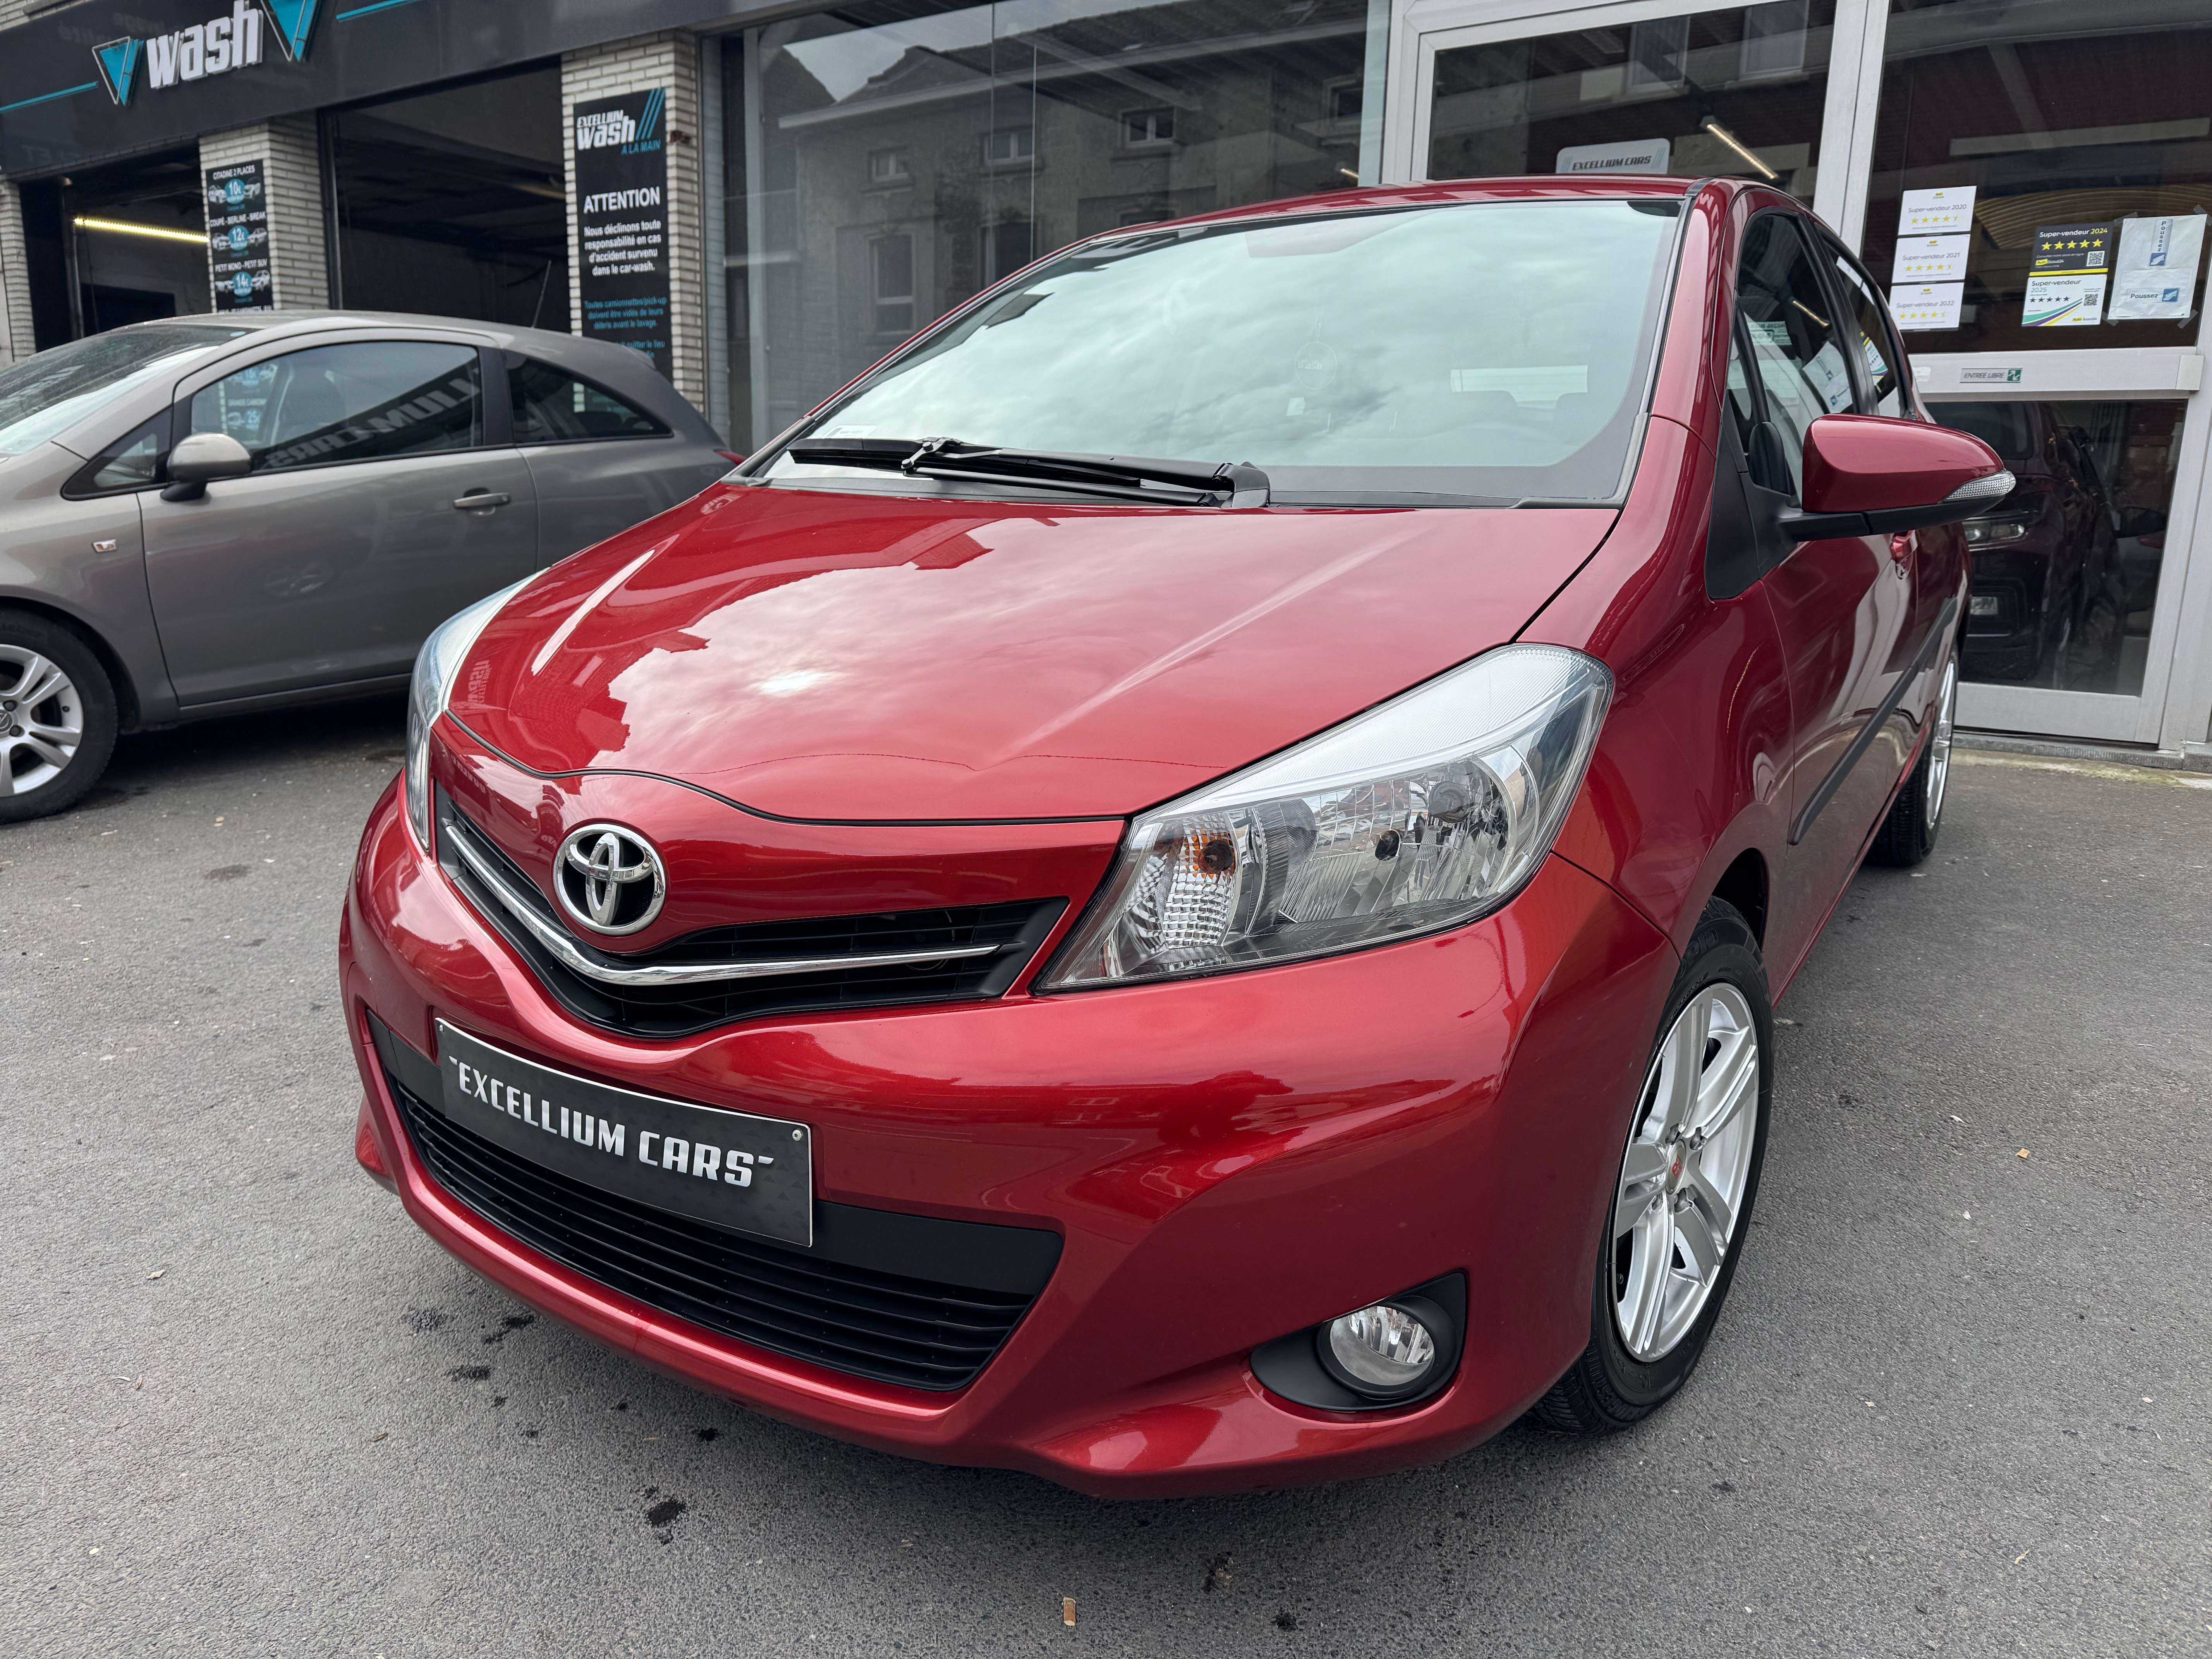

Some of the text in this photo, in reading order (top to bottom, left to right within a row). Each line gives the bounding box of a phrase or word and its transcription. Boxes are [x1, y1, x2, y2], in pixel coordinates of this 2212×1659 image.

[147, 0, 263, 88] wash
[577, 115, 635, 150] wash
[628, 143, 639, 154] LA
[641, 139, 661, 152] MAIN
[1572, 155, 1652, 170] EXCELLIUM CARS
[213, 169, 233, 180] CITADINE
[237, 165, 256, 175] PLACES
[583, 186, 660, 214] ATTENTION
[227, 213, 247, 225] BERLINE
[249, 211, 266, 221] BREAK
[584, 220, 661, 237] Nous déclinons toute
[2039, 230, 2090, 238] Super-vendeur
[584, 234, 661, 251] responsabilité en cas
[2157, 221, 2167, 252] Poussez
[589, 248, 658, 264] d'accident survenu
[215, 262, 228, 272] PETIT
[244, 259, 257, 269] PETIT
[258, 258, 267, 267] SUV
[592, 265, 610, 276] dans
[611, 264, 619, 275] le
[584, 300, 603, 309] Toutes
[639, 308, 647, 316] de
[648, 307, 664, 315] leurs
[630, 319, 636, 328] le
[459, 1061, 754, 1187] EXCELLIUM CARS
